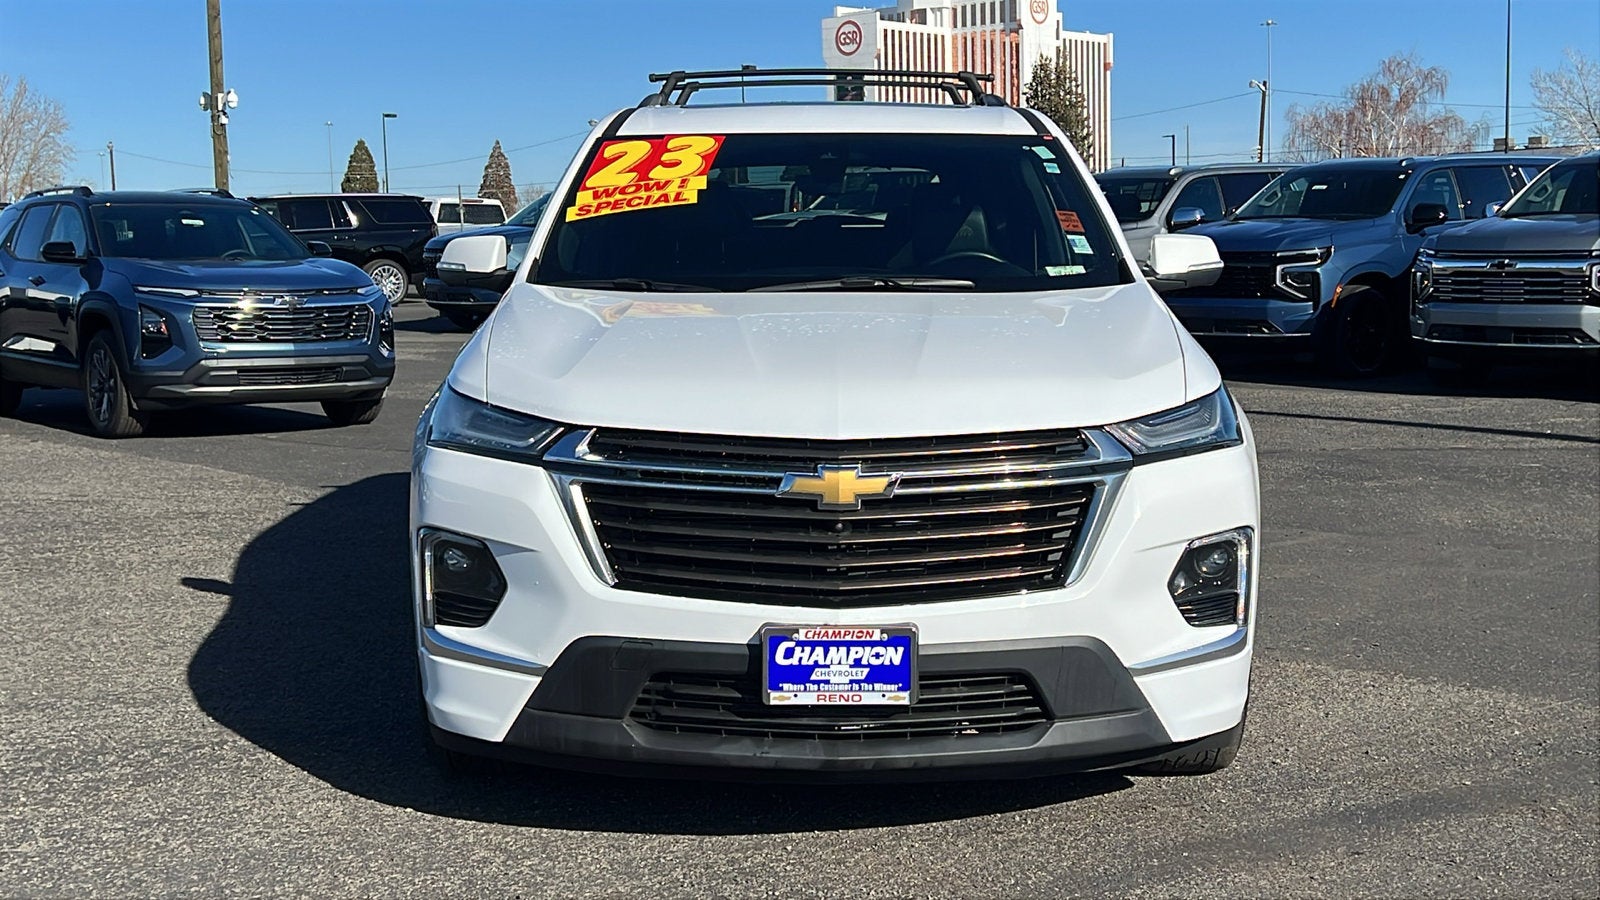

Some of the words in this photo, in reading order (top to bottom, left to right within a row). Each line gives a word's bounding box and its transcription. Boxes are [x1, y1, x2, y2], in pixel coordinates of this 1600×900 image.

[839, 30, 858, 46] GSR
[585, 136, 718, 188] 23
[575, 191, 689, 217] SPECIAL
[804, 630, 874, 639] CHAMPION
[775, 641, 904, 666] CHAMPION
[806, 683, 818, 691] The
[820, 683, 851, 691] Customer
[861, 683, 873, 691] The
[816, 694, 862, 702] RENO
